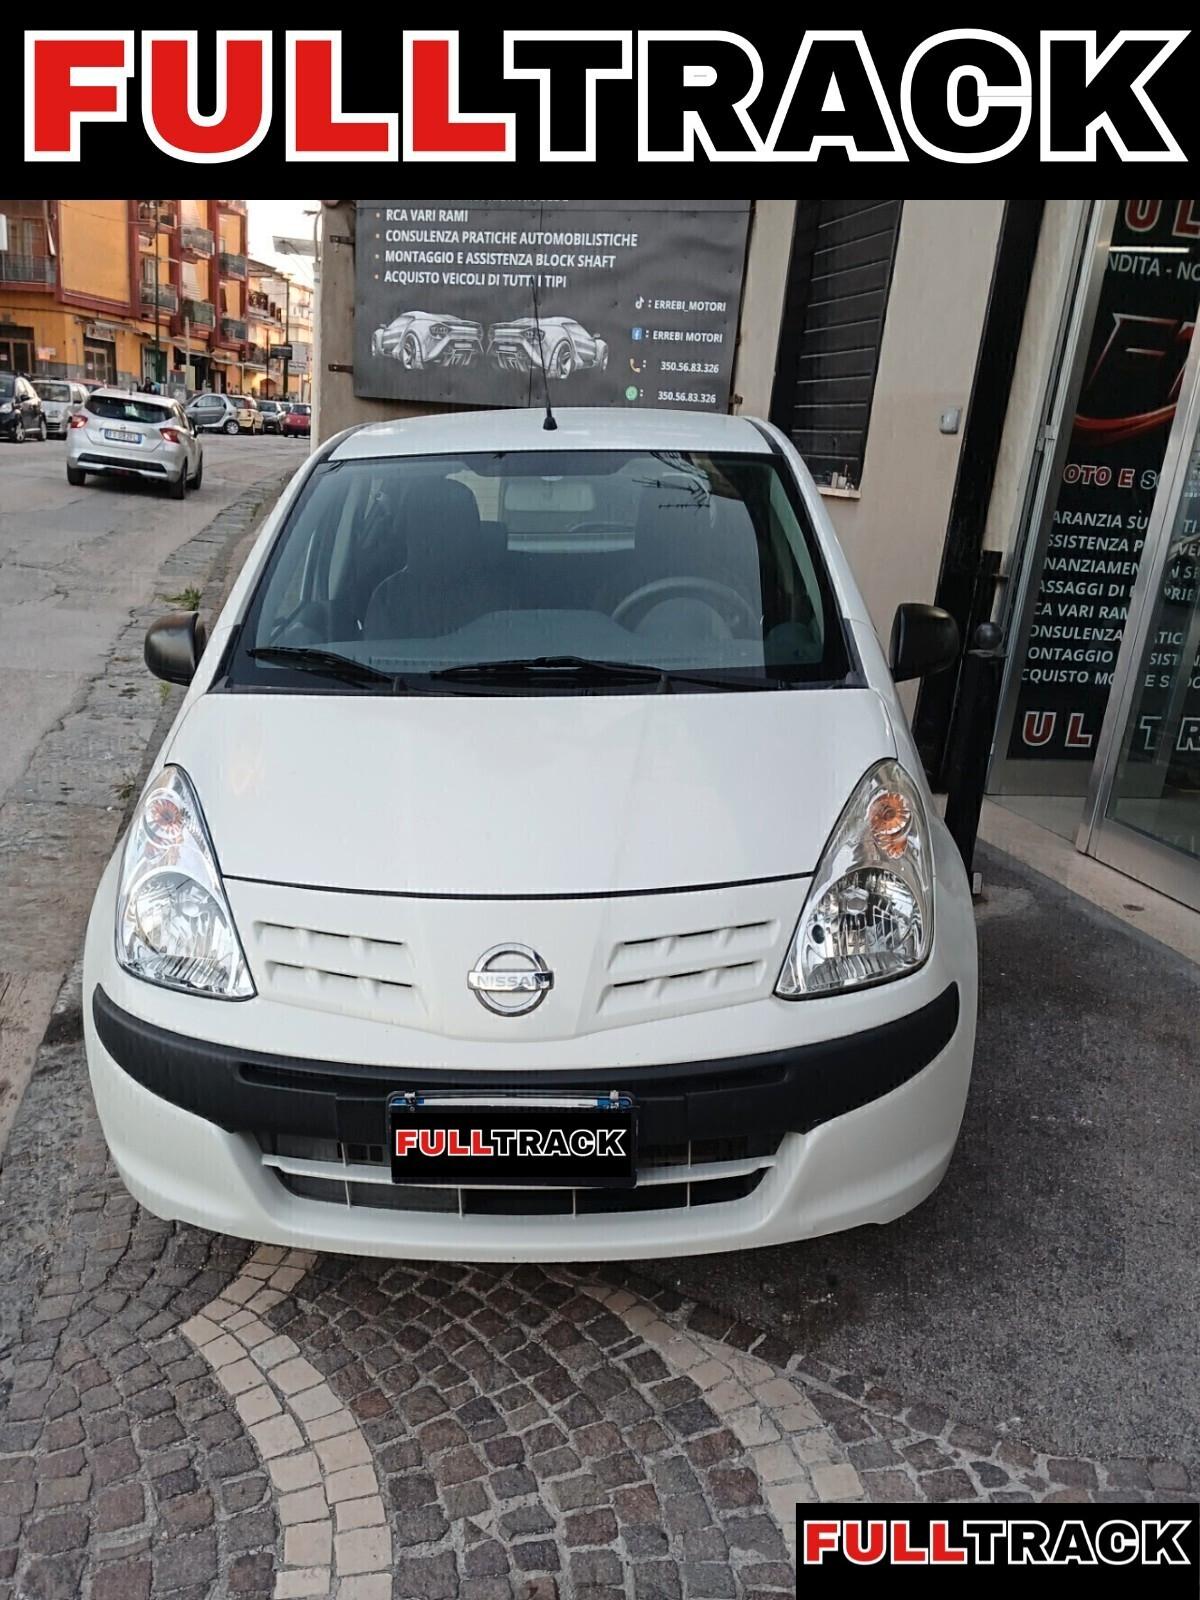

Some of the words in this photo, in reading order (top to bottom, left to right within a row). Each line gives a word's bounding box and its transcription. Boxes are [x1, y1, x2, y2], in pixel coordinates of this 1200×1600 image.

[386, 208, 408, 221] RCA
[410, 209, 436, 222] VARI
[438, 210, 469, 223] RAMI
[385, 229, 460, 244] CONSULENZA
[461, 231, 518, 245] PRATICHE
[519, 231, 639, 247] AUTOMOBILISTICHE
[385, 249, 455, 264] MONTAGGIO
[457, 252, 464, 264] E
[465, 251, 534, 266] ASSISTENZA
[535, 253, 576, 268] BLOCK
[577, 254, 617, 269] SHAFT
[384, 270, 440, 286] ACQUISTO
[442, 271, 486, 286] VEICOLI
[487, 273, 501, 287] DI
[537, 274, 542, 288] I
[544, 275, 567, 289] TIPI
[652, 330, 684, 341] ERREBI
[686, 332, 723, 344] MOTORI
[660, 361, 719, 374] 350.56.83.326
[658, 390, 717, 404] 350.56.83.326
[1117, 468, 1136, 488] E
[1140, 469, 1161, 490] S
[1108, 584, 1125, 598] DI
[1058, 603, 1095, 618] VARI
[476, 974, 547, 989] NISSAN
